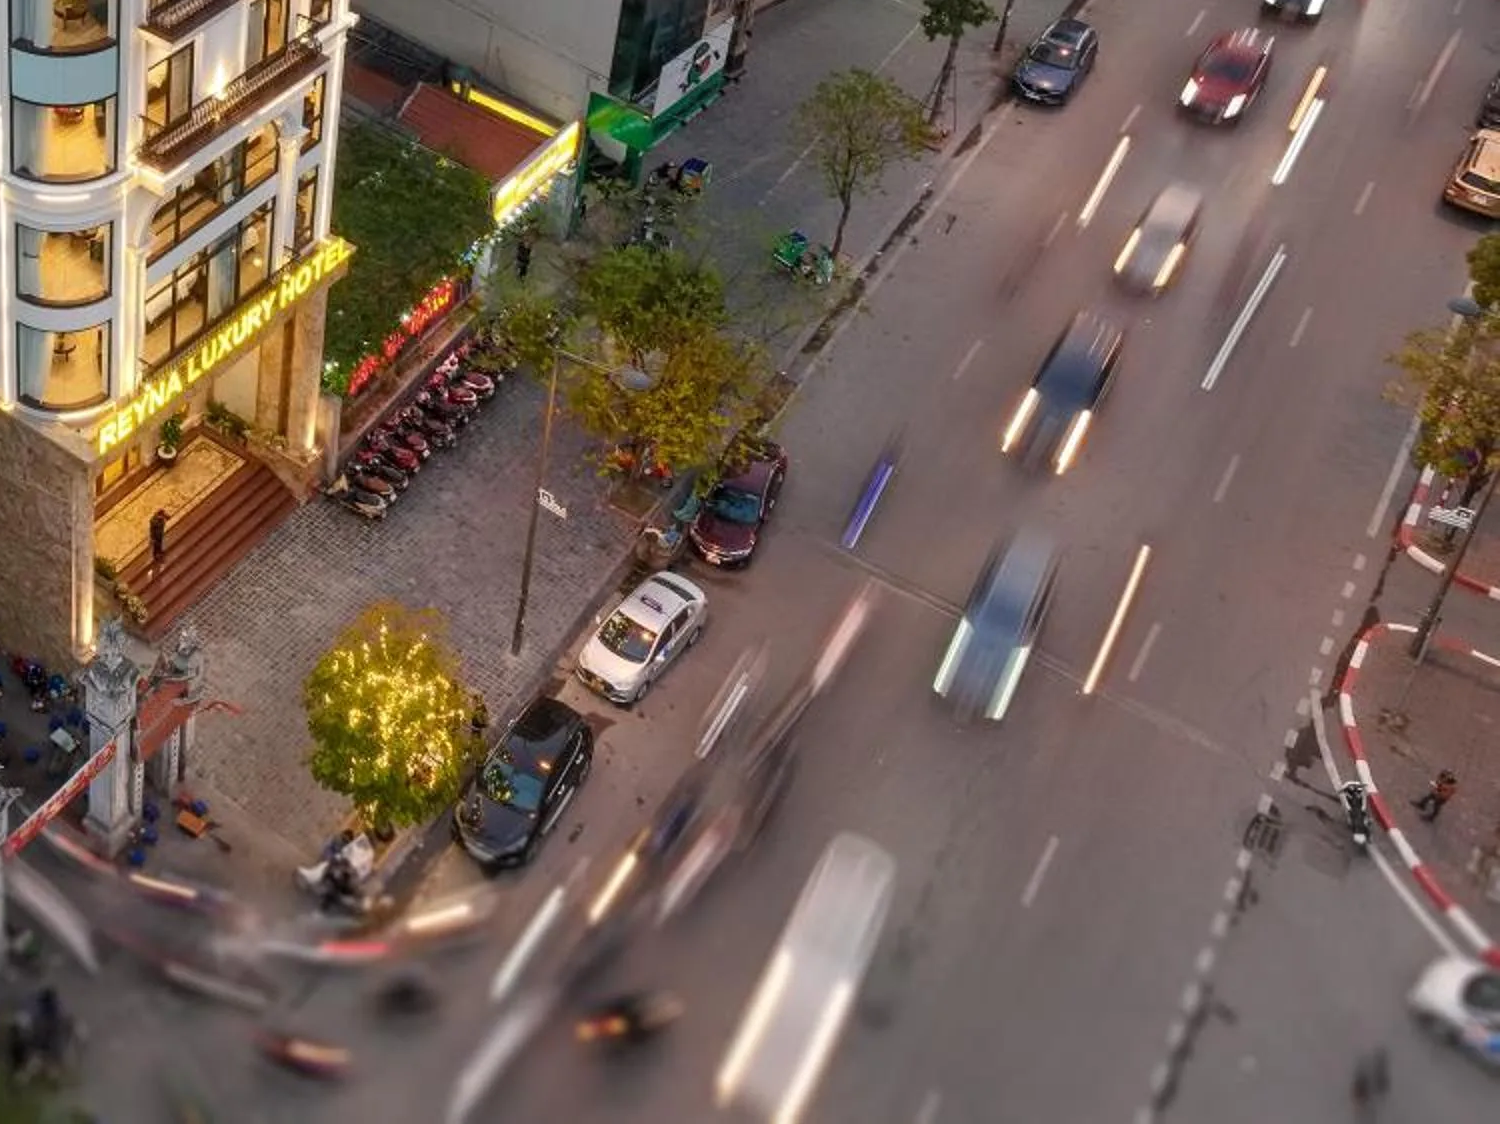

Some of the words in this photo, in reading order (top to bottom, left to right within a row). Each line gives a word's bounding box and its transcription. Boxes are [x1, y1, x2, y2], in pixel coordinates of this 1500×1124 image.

[99, 370, 184, 455] REYNA
[186, 289, 277, 383] LUXURY
[278, 236, 352, 309] HOTEL
